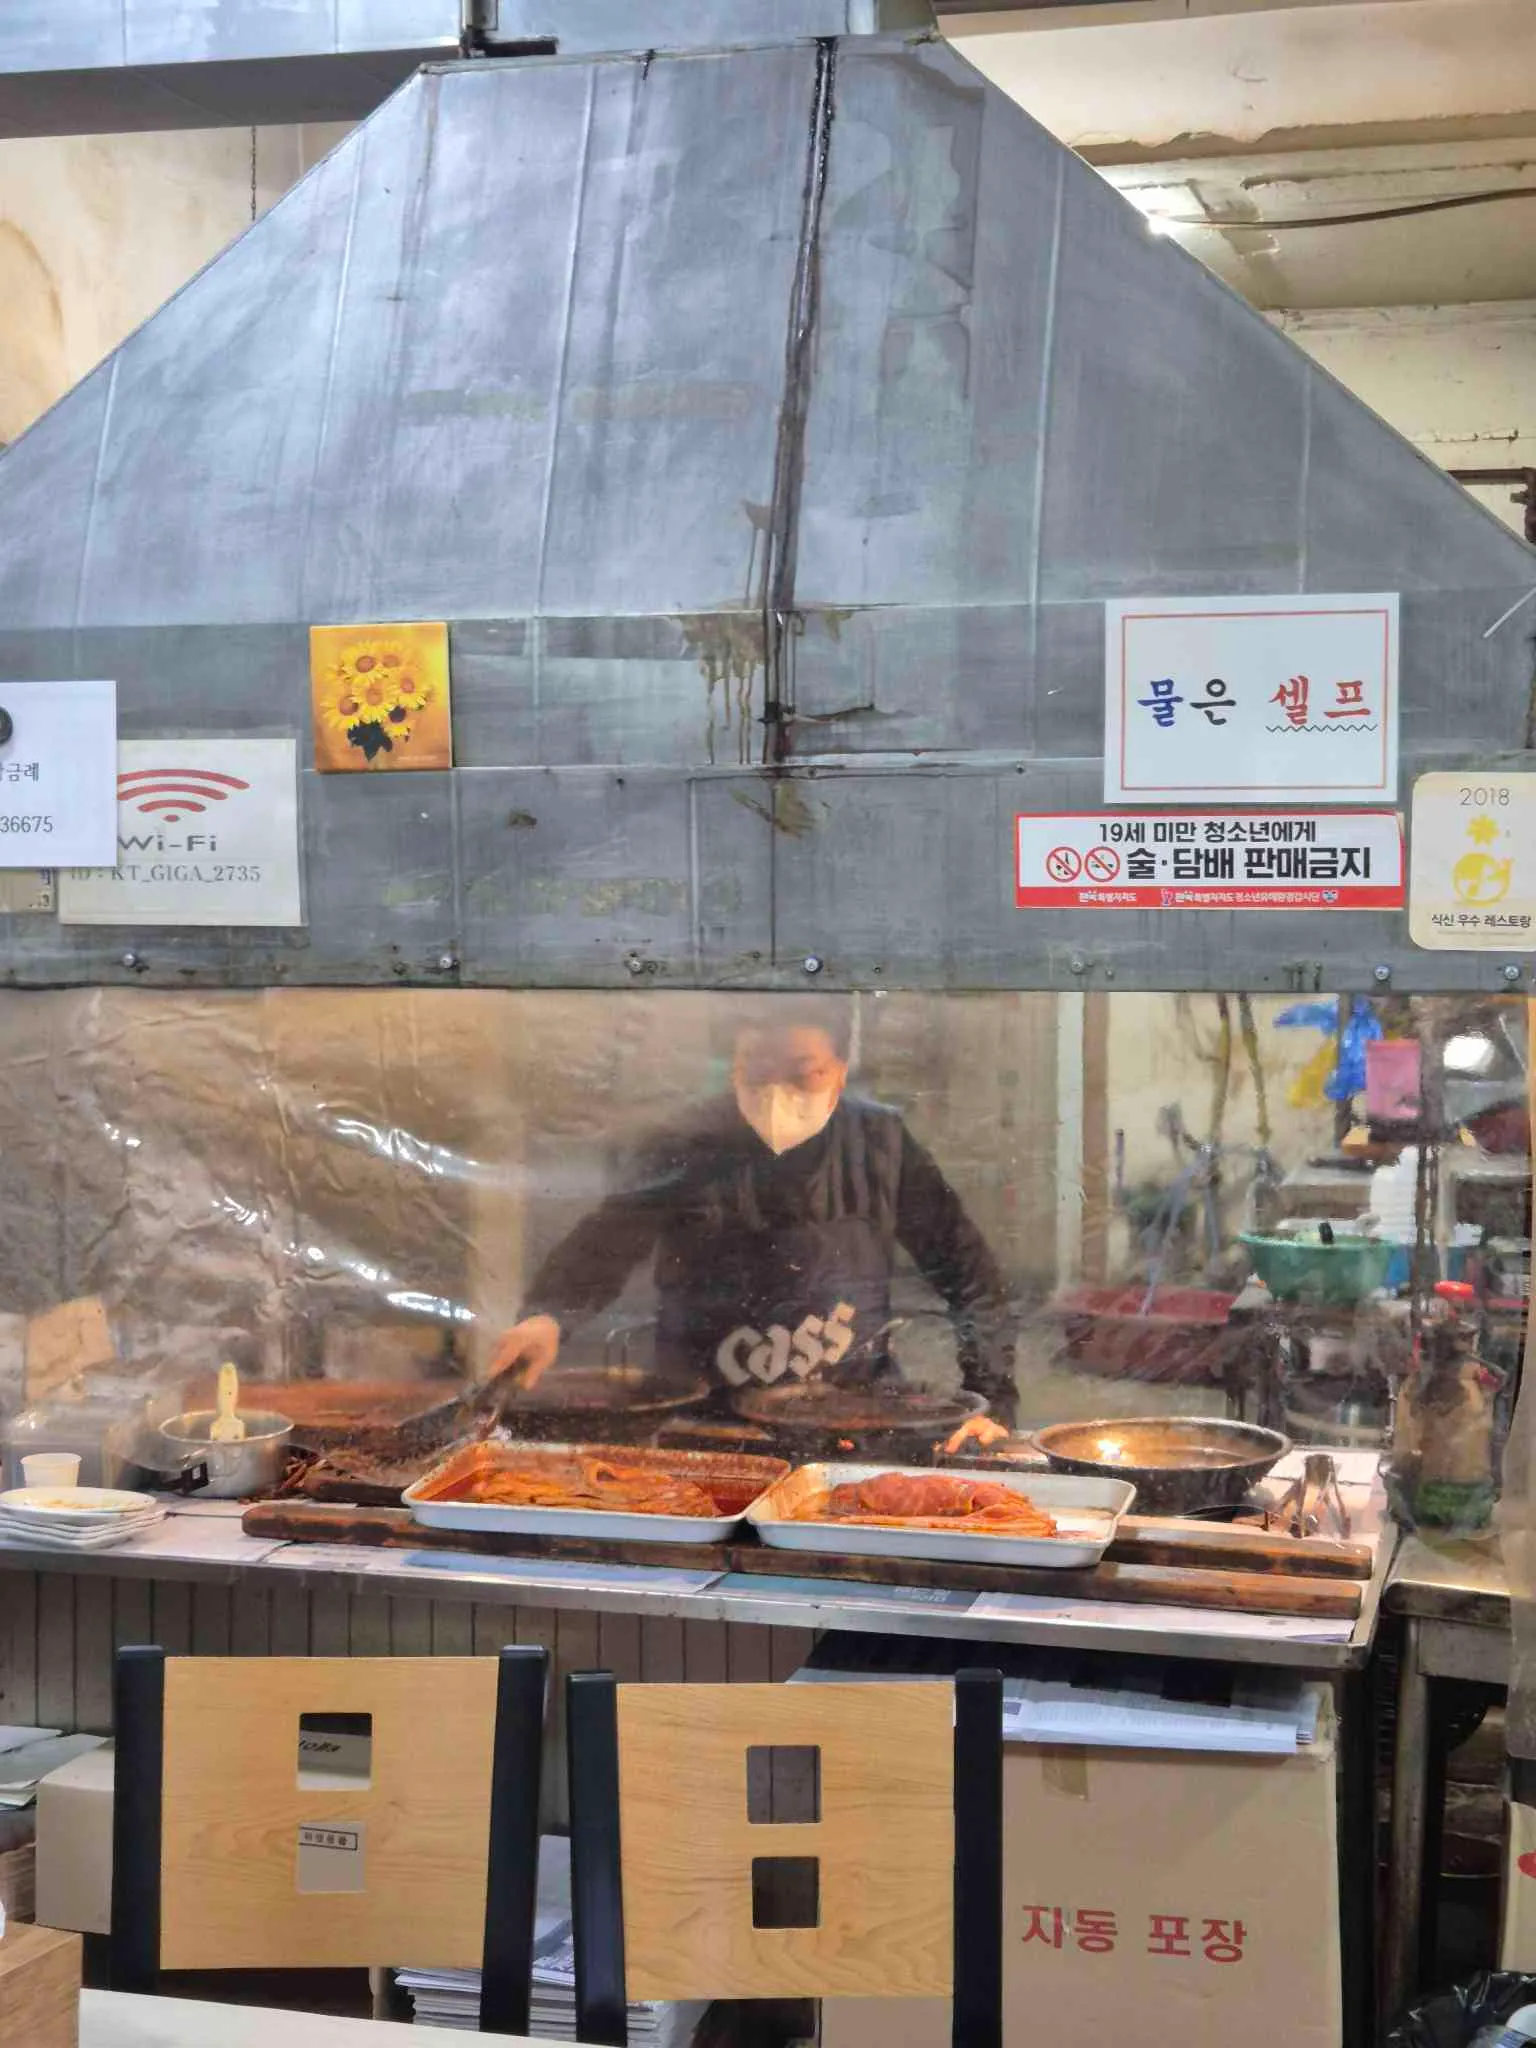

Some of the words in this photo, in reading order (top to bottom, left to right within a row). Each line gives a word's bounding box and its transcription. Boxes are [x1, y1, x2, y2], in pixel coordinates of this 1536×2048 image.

[1138, 678, 1236, 727] 물은
[1268, 675, 1372, 725] 셀프
[0, 762, 39, 782] 금레
[1459, 787, 1511, 806] 2018
[1099, 823, 1145, 844] 19세
[1153, 822, 1196, 844] 미만
[1204, 821, 1316, 844] 청소년에게
[118, 834, 217, 852] Wi-Fi
[1127, 847, 1234, 879] 술·담배
[1243, 846, 1371, 879] 판매금지
[111, 864, 261, 883] KT_GIGA_2735
[1431, 913, 1455, 926] 식신
[1457, 913, 1481, 927] 우수
[1021, 1904, 1118, 1954] 자동
[1147, 1914, 1248, 1963] 포장
